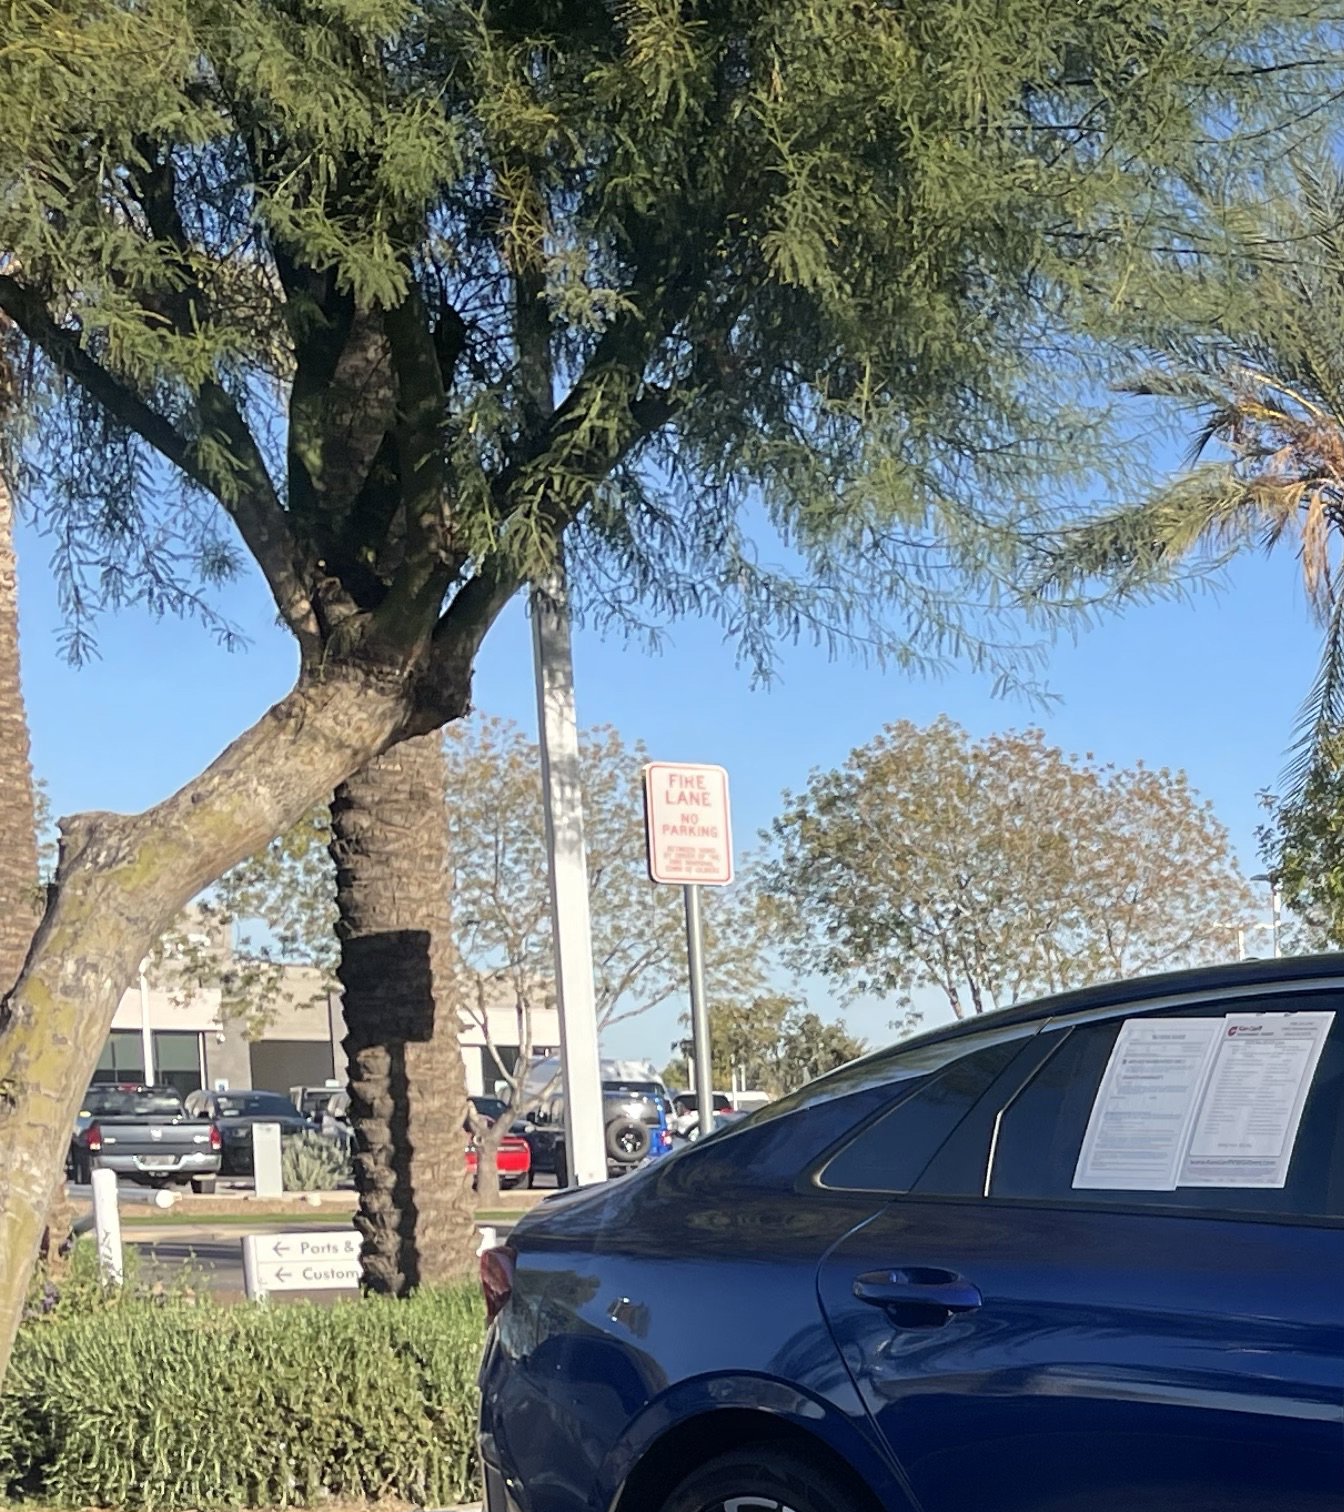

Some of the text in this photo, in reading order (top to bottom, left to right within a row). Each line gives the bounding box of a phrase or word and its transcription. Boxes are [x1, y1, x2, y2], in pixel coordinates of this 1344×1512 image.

[669, 773, 706, 790] FIRE
[665, 790, 712, 807] LANE
[681, 813, 699, 825] NO
[662, 824, 718, 838] PARKING
[301, 1240, 354, 1254] Parts &
